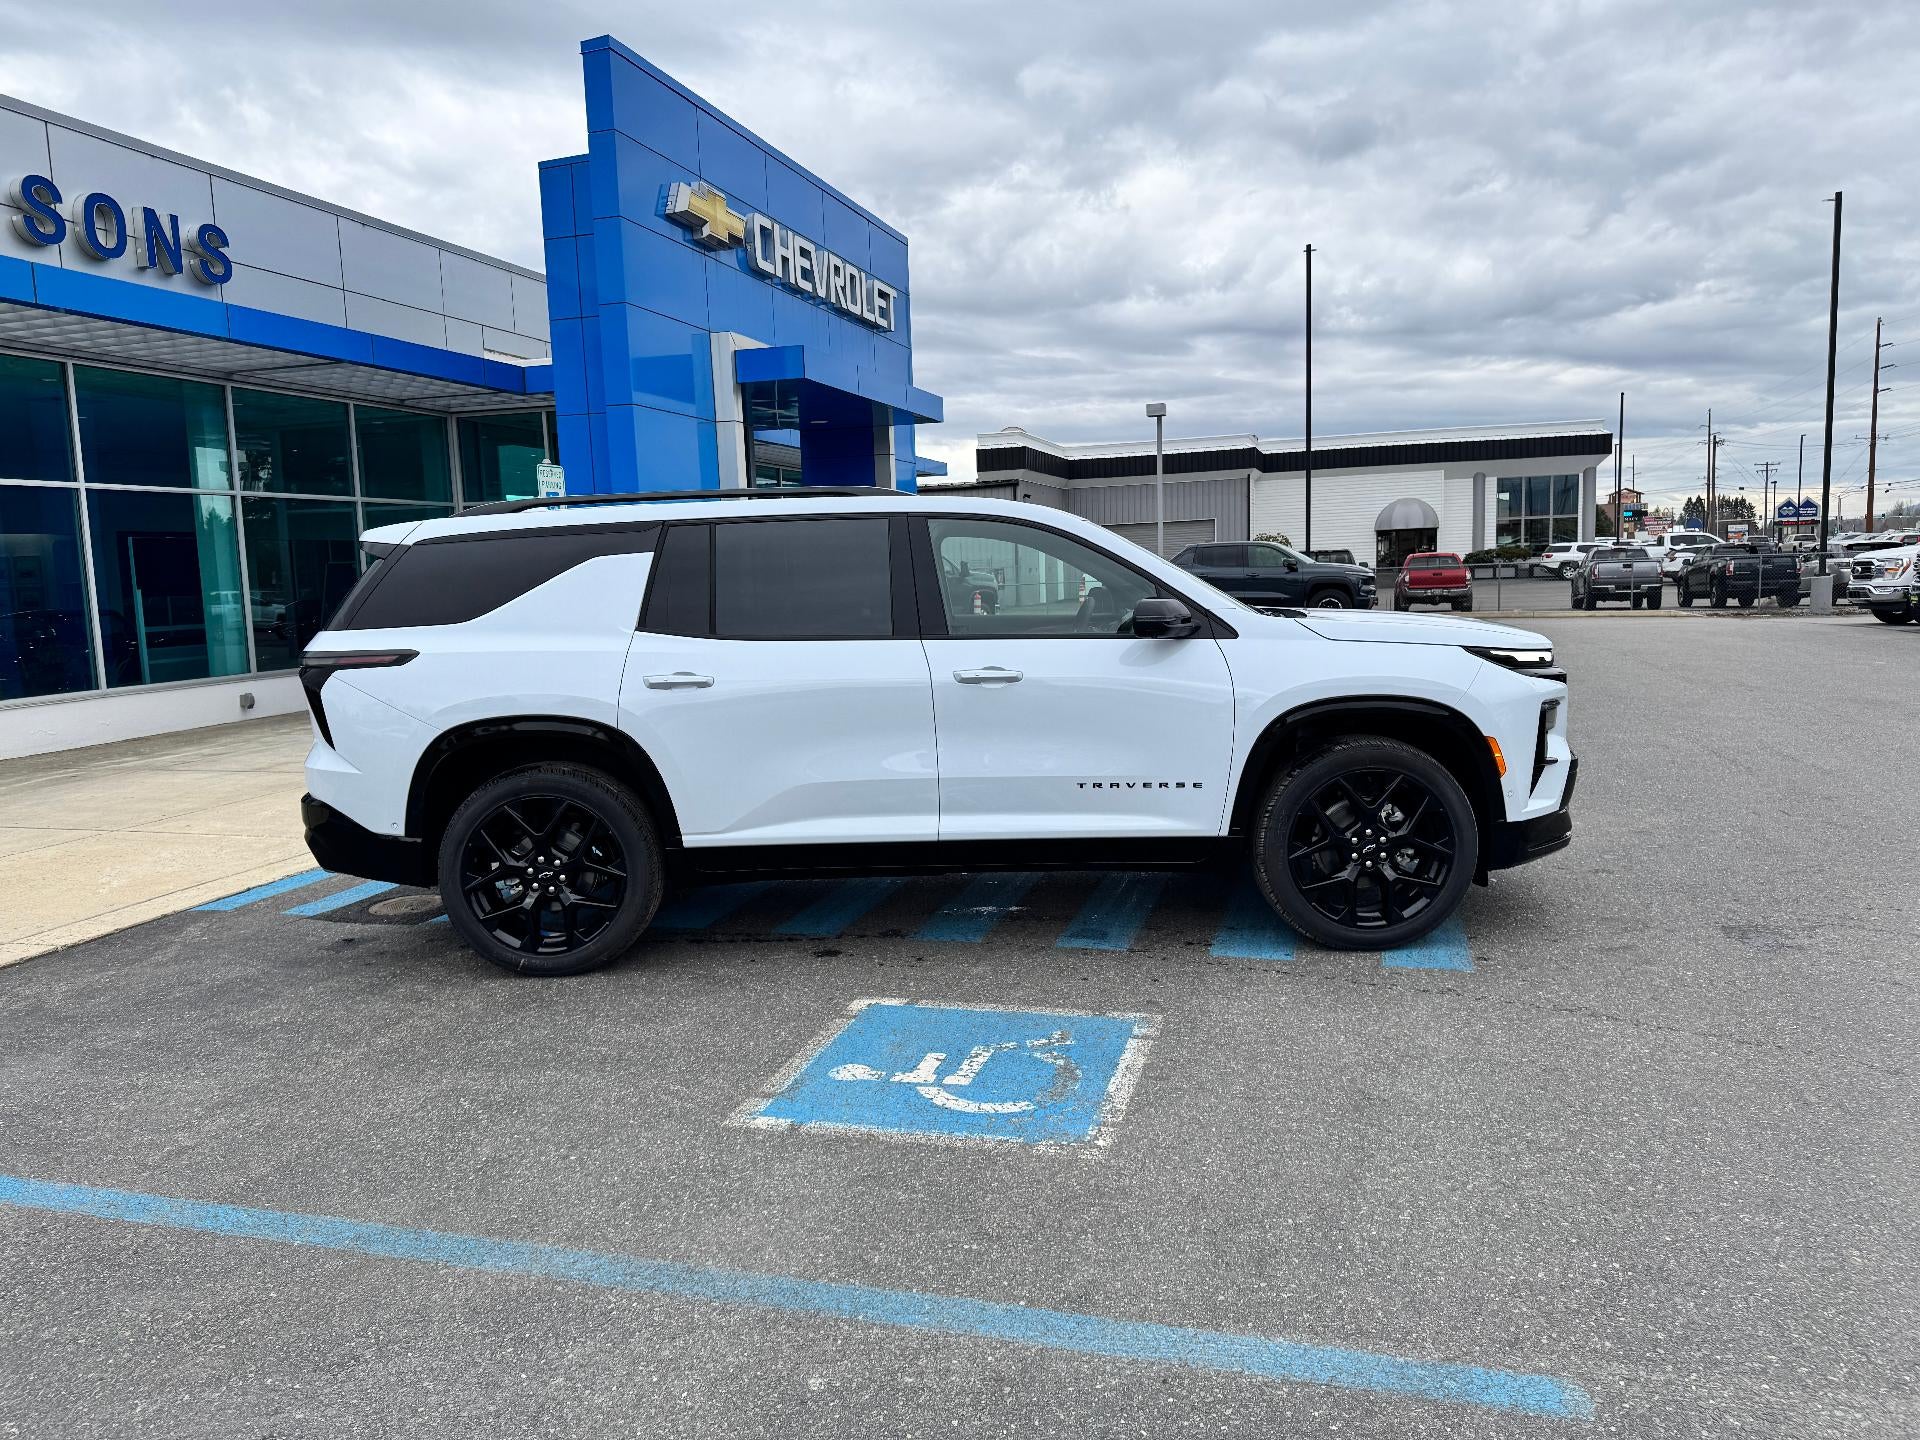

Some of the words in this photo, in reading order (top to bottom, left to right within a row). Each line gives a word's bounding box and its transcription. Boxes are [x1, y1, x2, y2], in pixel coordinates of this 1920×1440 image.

[16, 174, 233, 285] SONS
[749, 212, 898, 332] CHEVROLET
[1076, 781, 1203, 789] TRAVERSE
